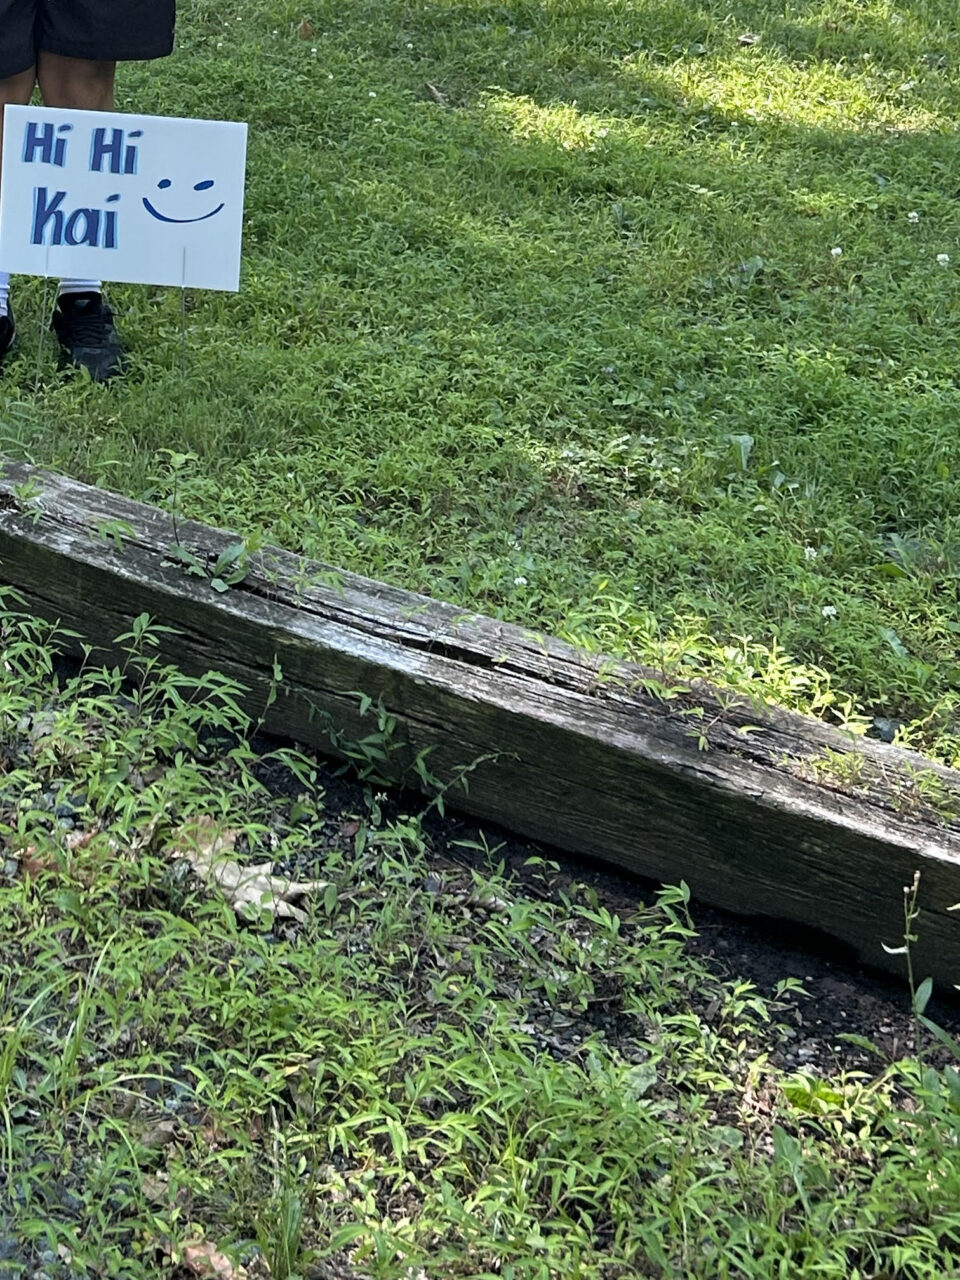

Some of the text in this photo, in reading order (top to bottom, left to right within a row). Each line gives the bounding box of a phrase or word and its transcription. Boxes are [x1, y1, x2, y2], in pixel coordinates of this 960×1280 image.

[21, 122, 144, 175] Hi Hi
[30, 186, 121, 249] Kai
